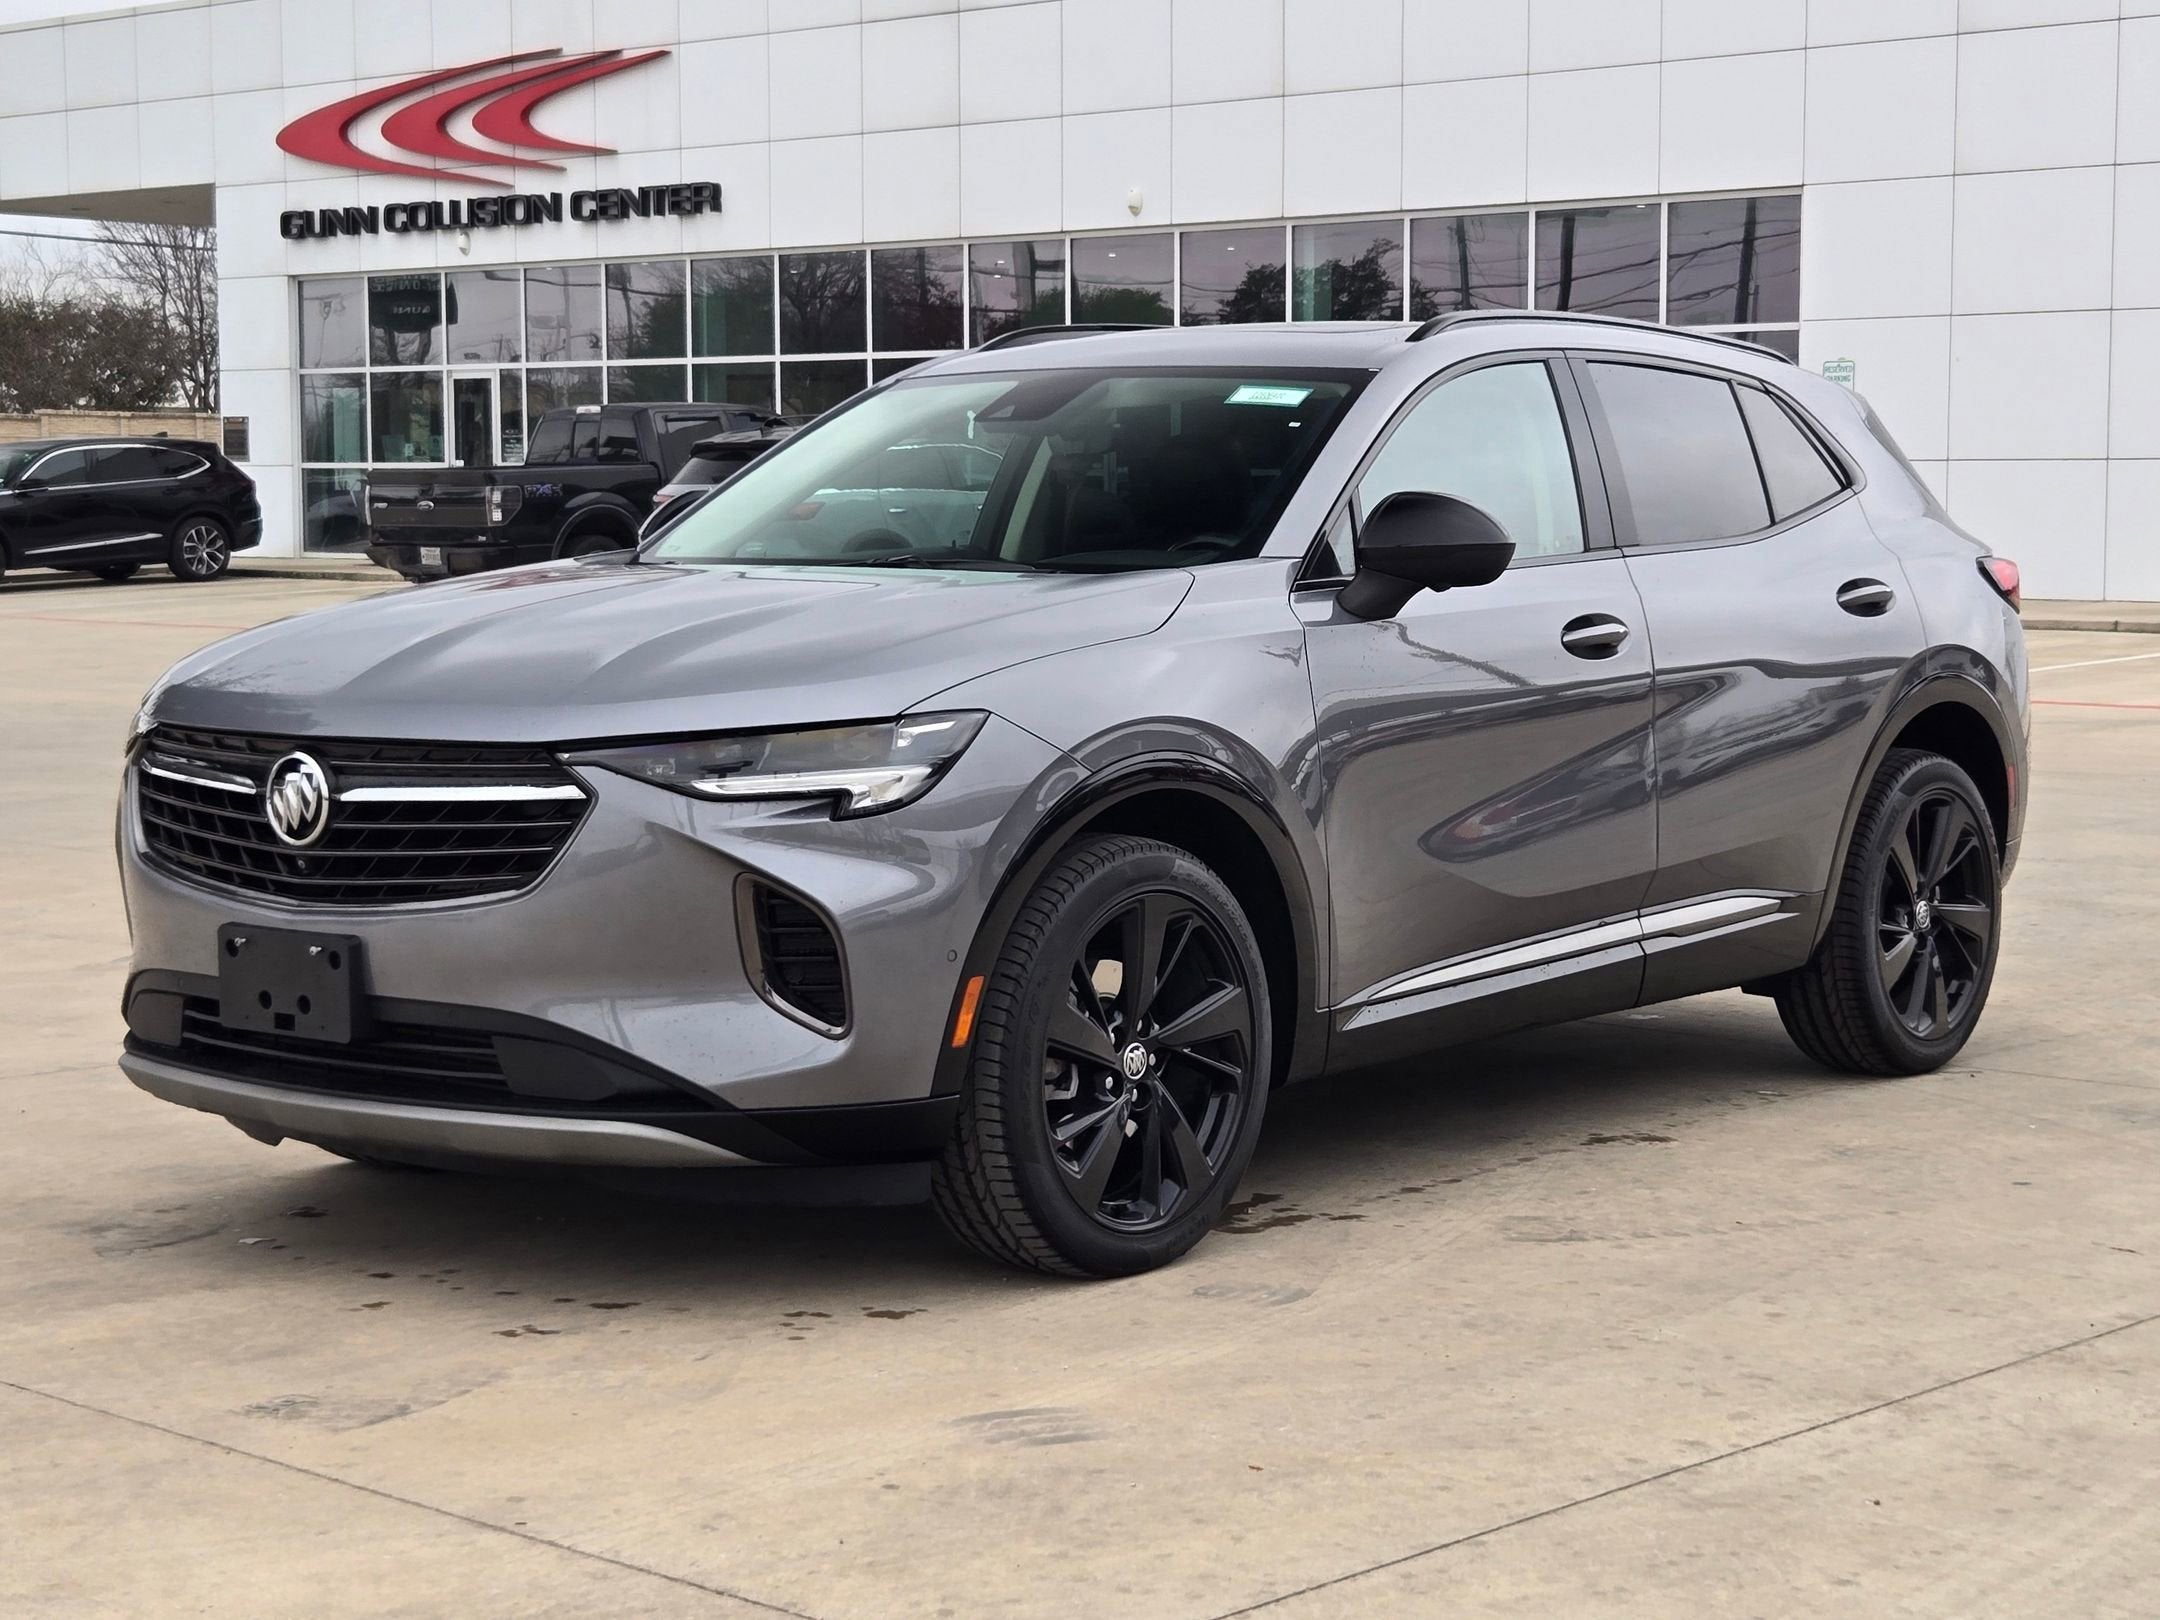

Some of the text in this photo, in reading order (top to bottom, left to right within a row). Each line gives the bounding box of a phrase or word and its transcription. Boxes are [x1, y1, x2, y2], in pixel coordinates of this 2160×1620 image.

[280, 182, 723, 239] GUNN COLLISION CENTER
